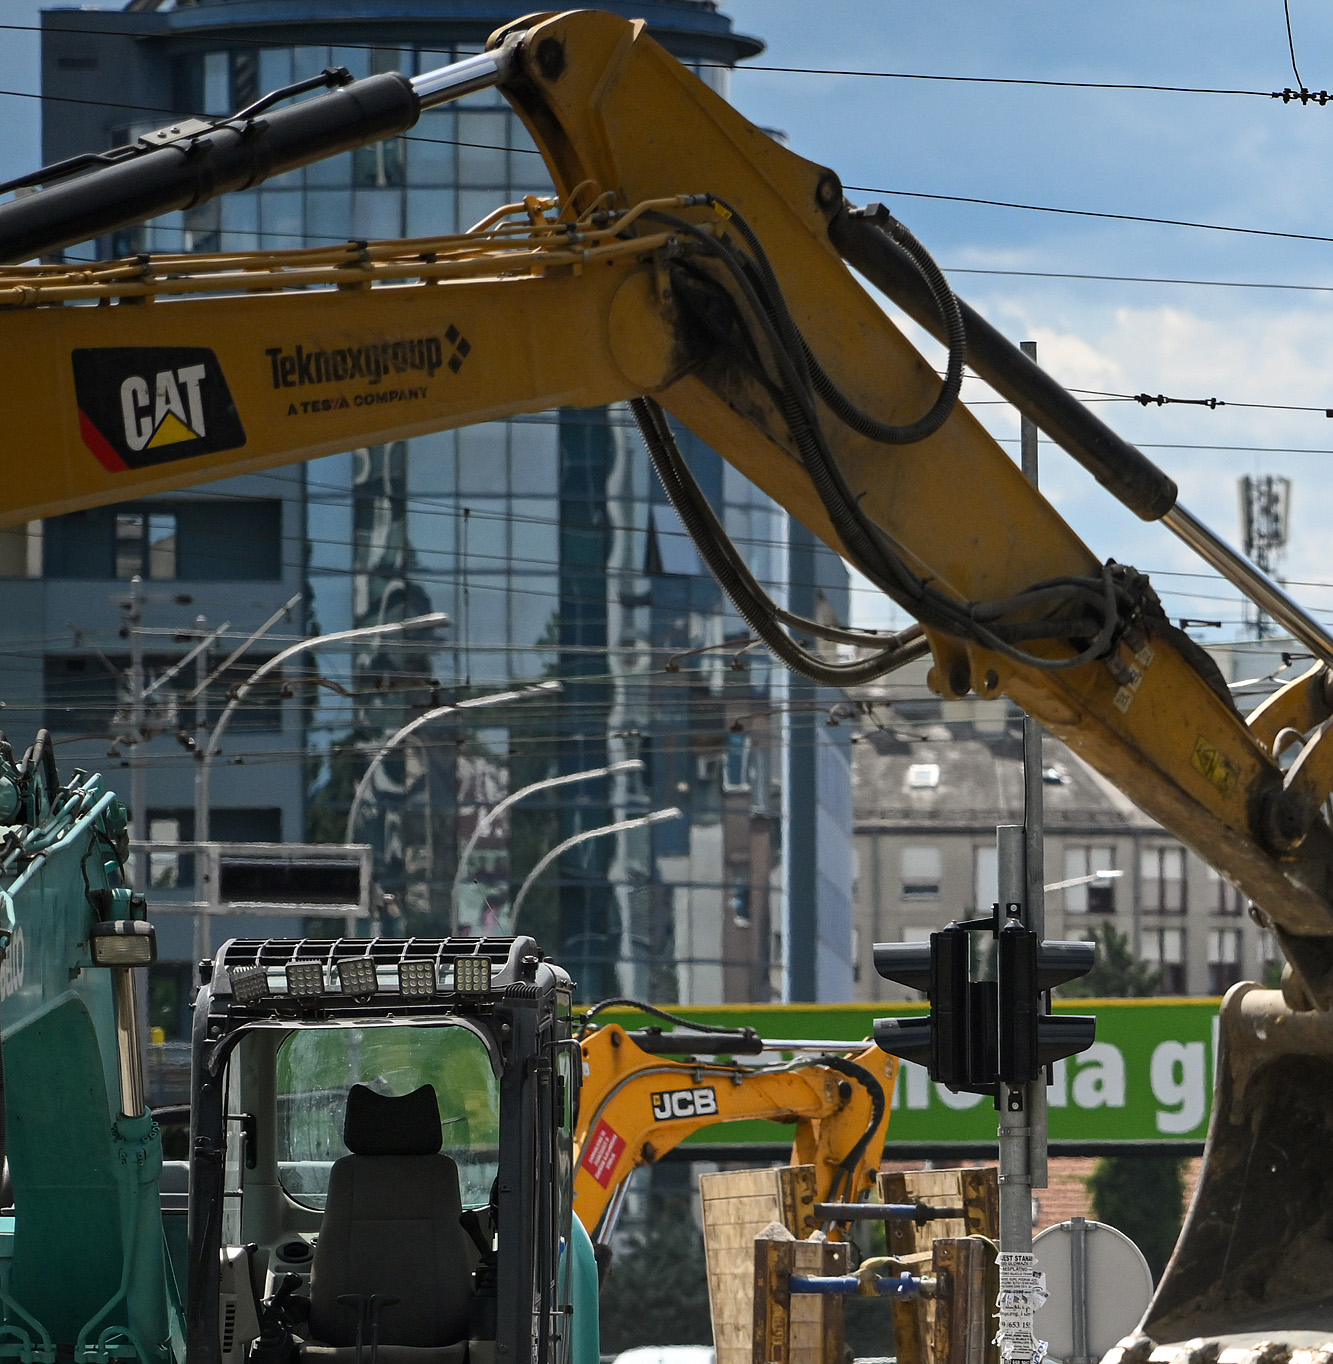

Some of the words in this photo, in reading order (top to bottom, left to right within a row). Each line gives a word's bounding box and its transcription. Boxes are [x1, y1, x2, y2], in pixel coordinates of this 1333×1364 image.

[265, 337, 443, 390] Teknoxgroup
[120, 364, 206, 451] CAT
[286, 403, 298, 417] A
[353, 386, 428, 408] COMPANY
[654, 1088, 717, 1120] JCB
